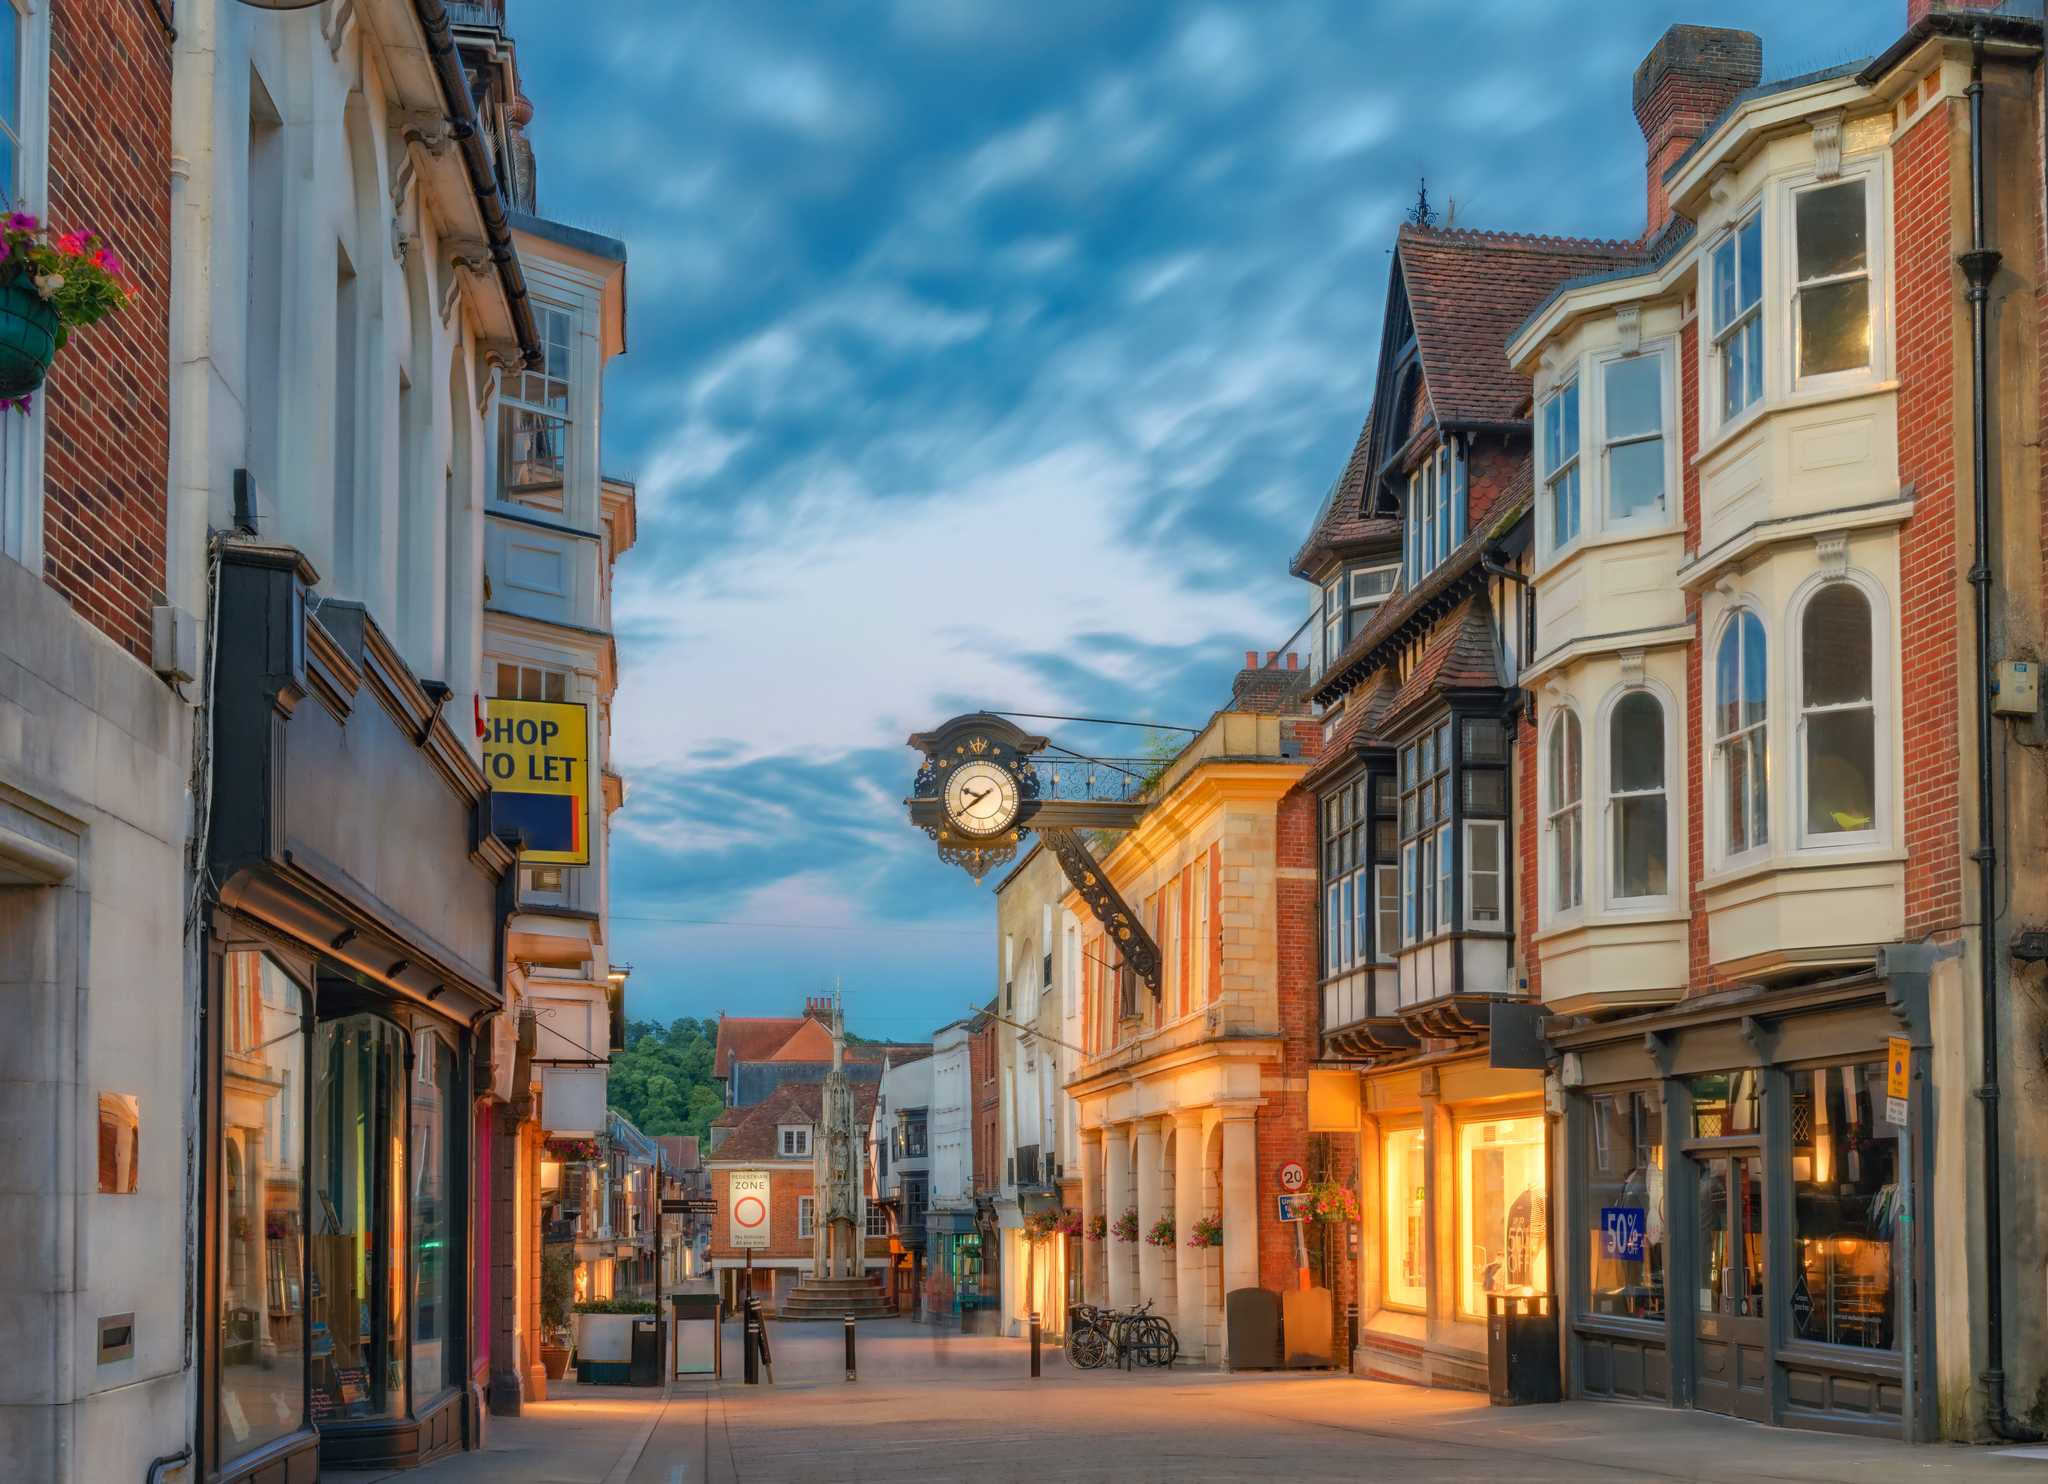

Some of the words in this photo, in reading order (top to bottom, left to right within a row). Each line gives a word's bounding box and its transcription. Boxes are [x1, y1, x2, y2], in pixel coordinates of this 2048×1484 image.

[528, 755, 577, 782] LET
[735, 1181, 765, 1190] ZONE
[1284, 1170, 1302, 1184] 20
[1607, 1213, 1639, 1254] 50%
